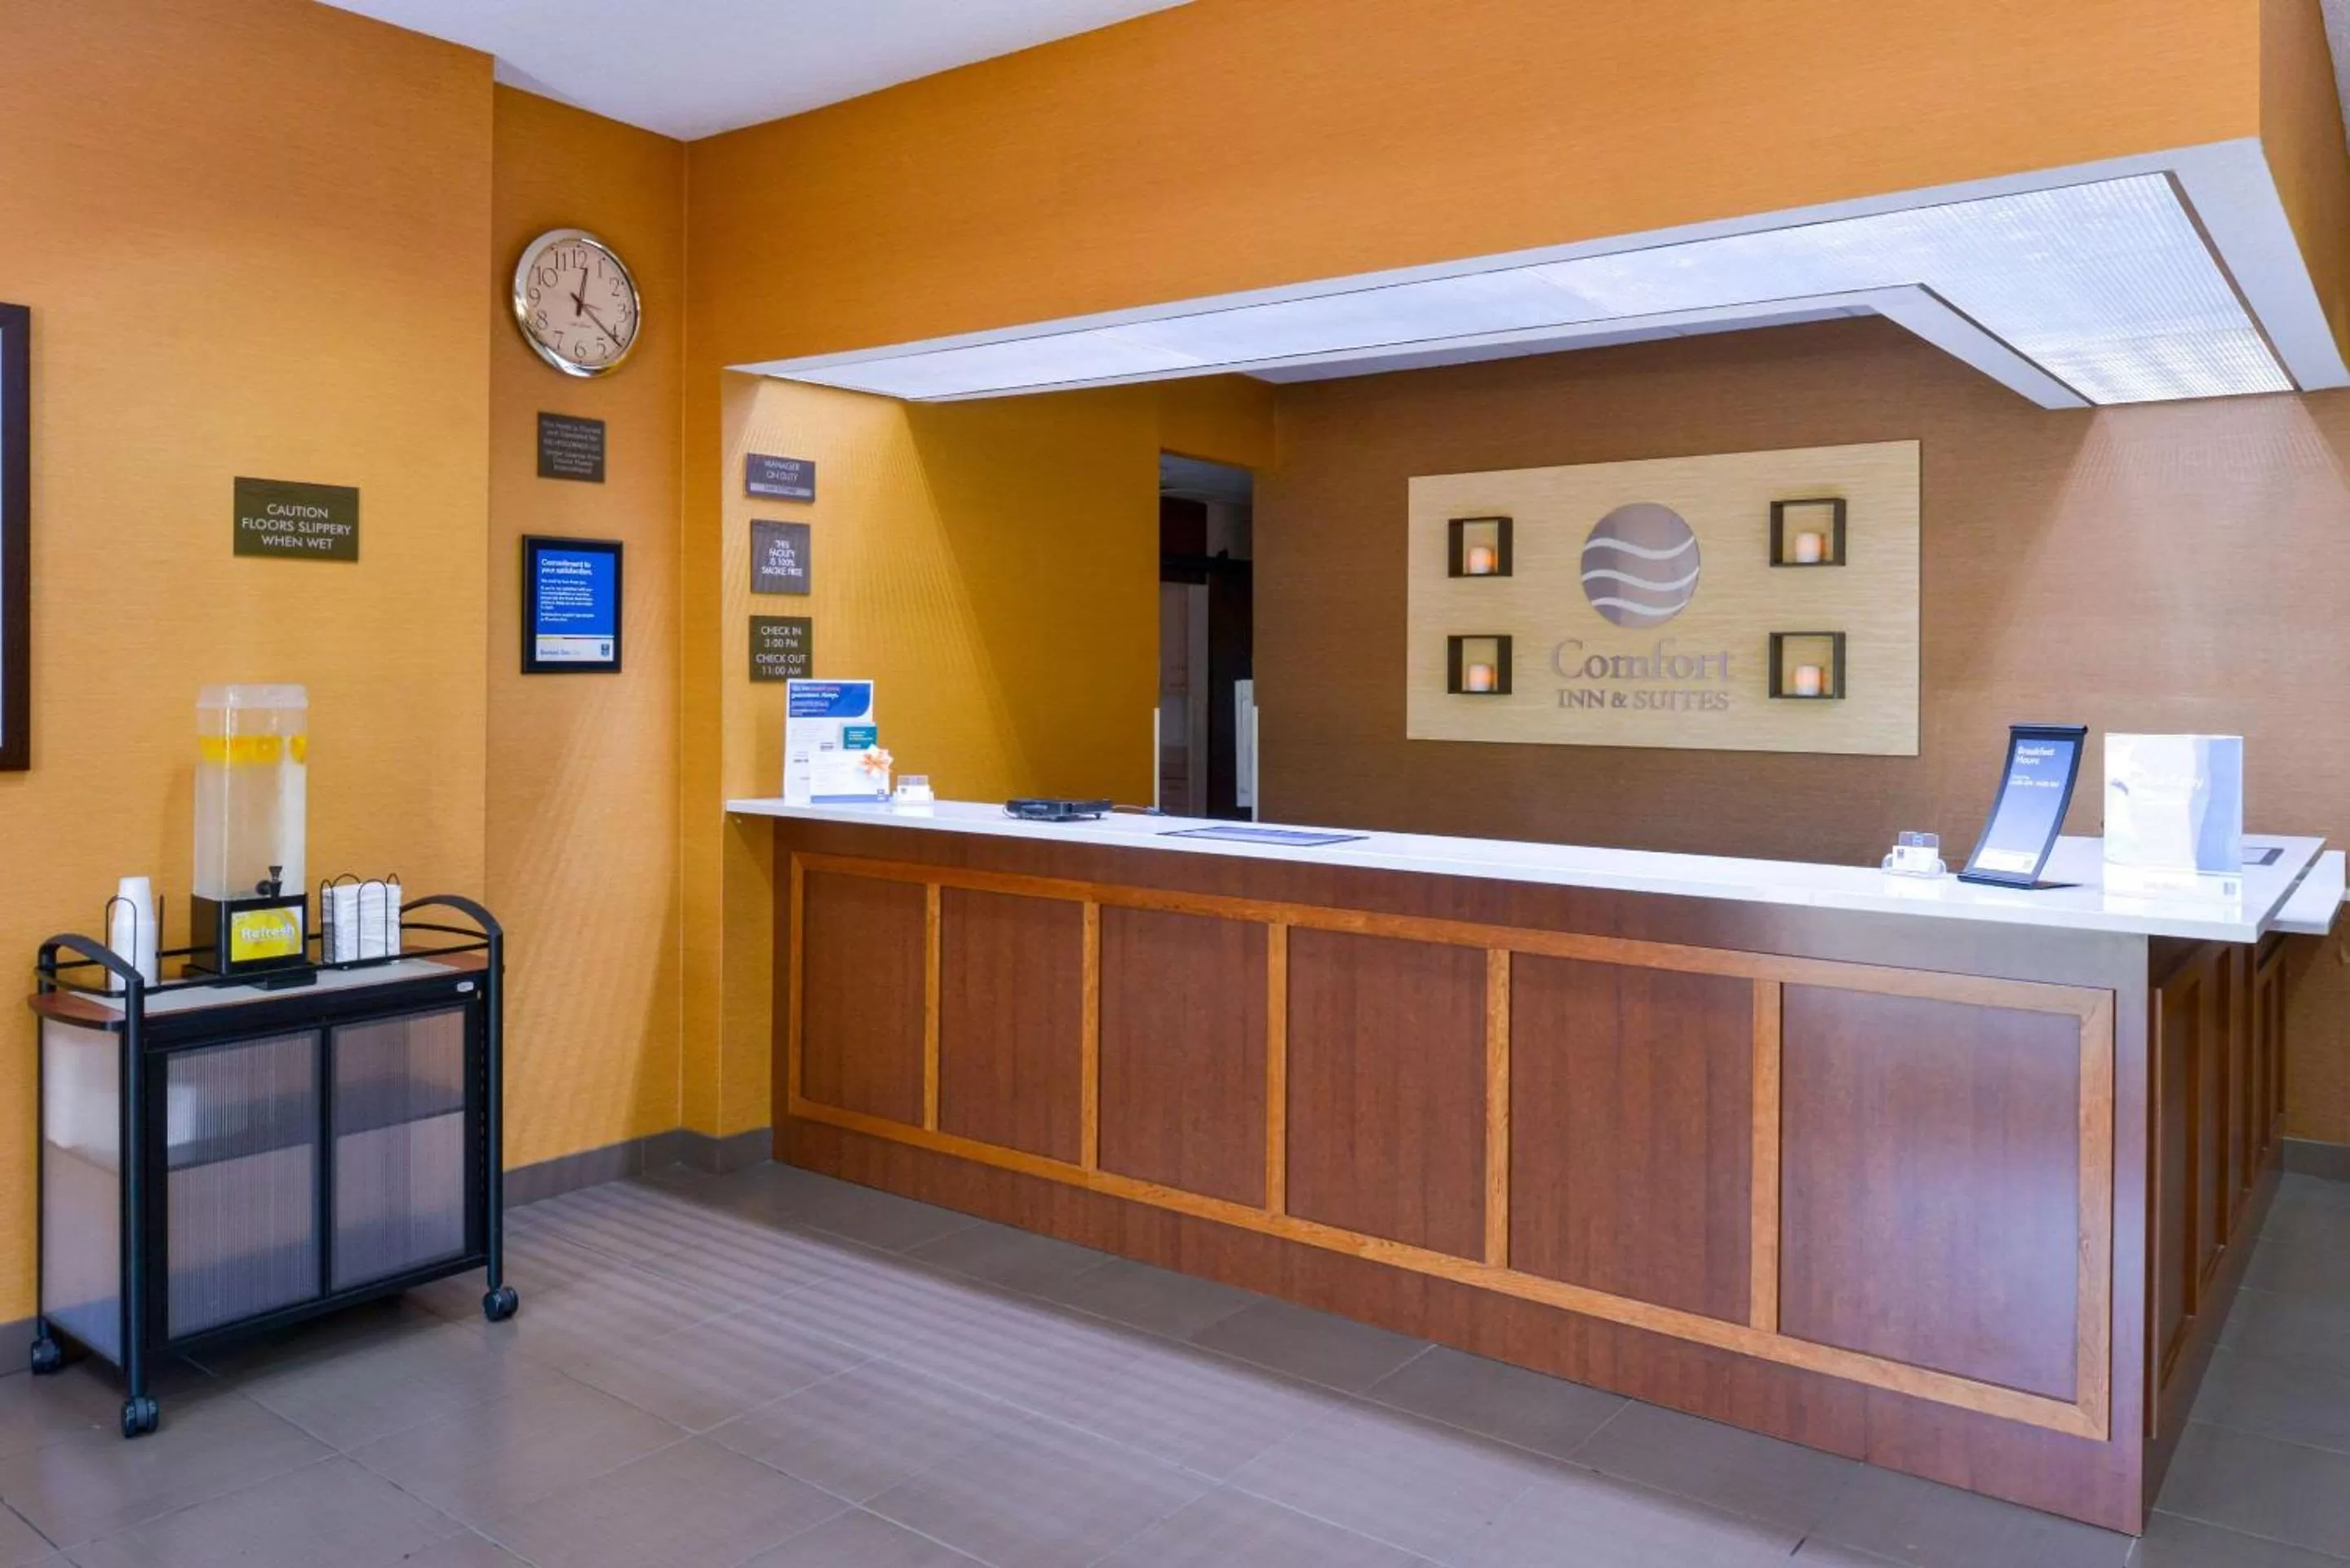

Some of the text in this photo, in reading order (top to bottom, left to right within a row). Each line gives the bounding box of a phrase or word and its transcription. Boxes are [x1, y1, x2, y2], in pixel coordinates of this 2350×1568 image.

[555, 250, 567, 271] 11
[572, 249, 588, 269] 12
[536, 265, 558, 288] 10
[610, 277, 621, 296] 2
[530, 287, 541, 307] 9
[535, 309, 548, 330] 8
[617, 303, 627, 323] 3
[552, 330, 564, 350] 7
[574, 339, 587, 358] 6
[596, 337, 606, 357] 5
[267, 503, 328, 519] CAUTION
[242, 517, 352, 536] FLOORS SLIPPERY
[261, 534, 334, 550] WHEN WET
[760, 626, 802, 636] CHECK IN
[785, 639, 799, 648] PM
[756, 653, 806, 664] CHECK OUT
[1552, 637, 1730, 682] Comfort
[762, 666, 801, 675] 11:00 AM
[1556, 689, 1731, 711] INN & SUITES
[241, 924, 295, 942] Refresh
